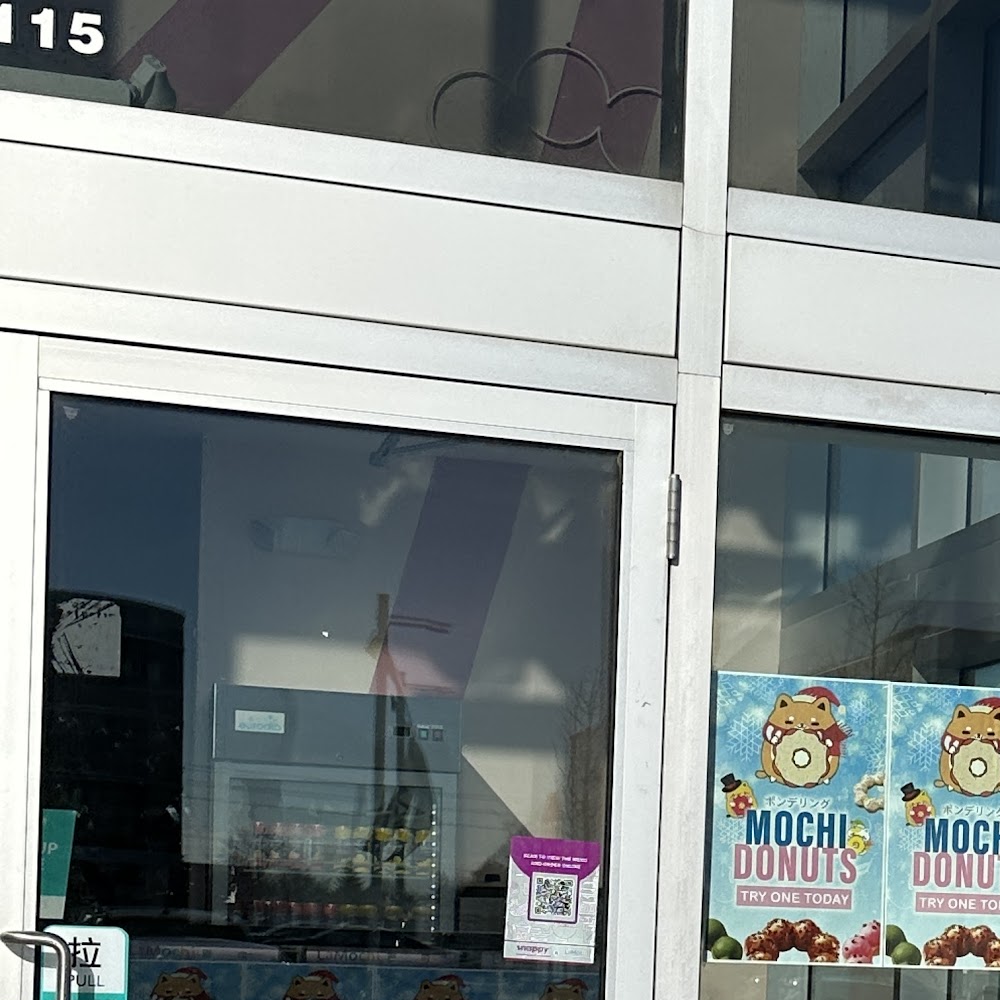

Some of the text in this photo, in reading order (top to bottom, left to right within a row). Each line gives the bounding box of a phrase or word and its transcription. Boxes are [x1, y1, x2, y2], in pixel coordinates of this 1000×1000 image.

[765, 795, 830, 809] ポンデリング
[746, 810, 847, 850] MOCHI
[733, 843, 858, 884] DONUTS
[741, 890, 850, 906] TRY ONE TODAY
[920, 896, 944, 909] TRY
[948, 898, 976, 910] ONE
